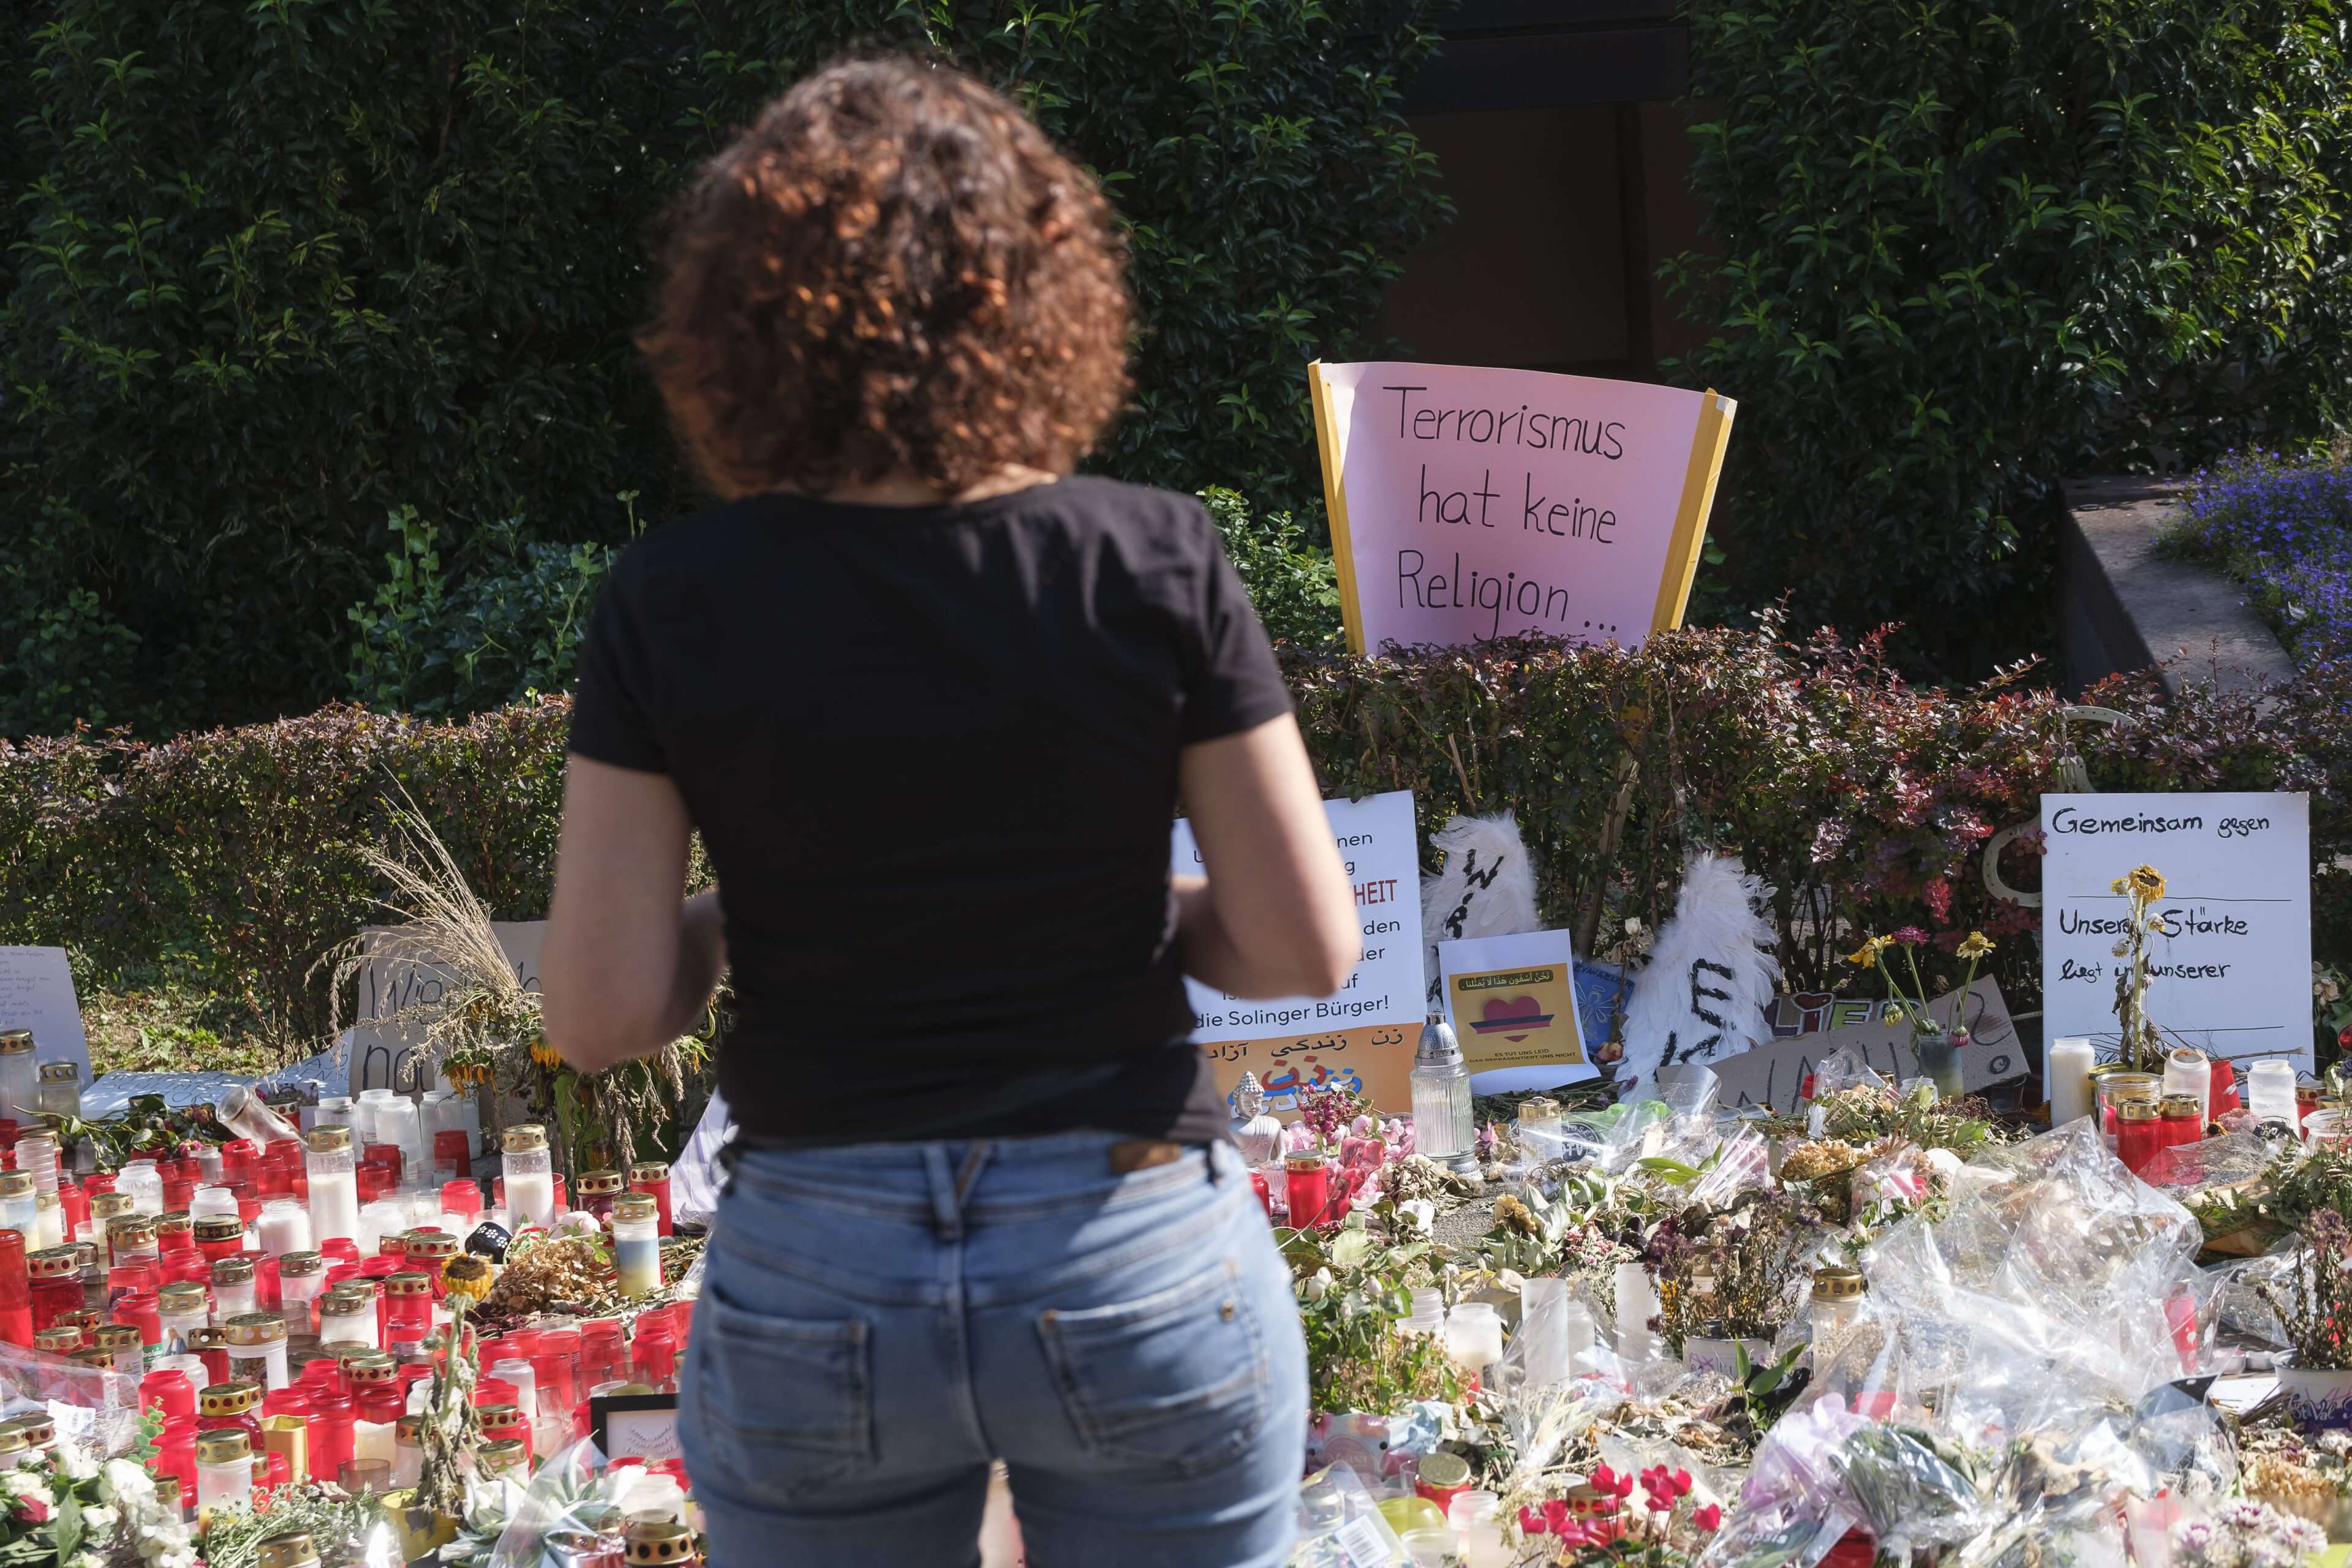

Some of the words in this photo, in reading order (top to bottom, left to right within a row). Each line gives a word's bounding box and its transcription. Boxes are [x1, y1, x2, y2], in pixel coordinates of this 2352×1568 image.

[1382, 386, 1626, 460] Terrorismus
[1418, 464, 1500, 527] hat
[1523, 472, 1616, 544] keine
[2052, 807, 2203, 834] Gemeinsam
[2217, 816, 2270, 838] gegen
[1336, 832, 1373, 848] nen
[1353, 879, 1398, 906] HEIT
[2160, 905, 2248, 938] Stärke
[1229, 1007, 1311, 1026] Solinger
[1317, 995, 1389, 1018] Bürger!
[1207, 1042, 1249, 1061] آزاد
[1372, 1029, 1403, 1046] زن
